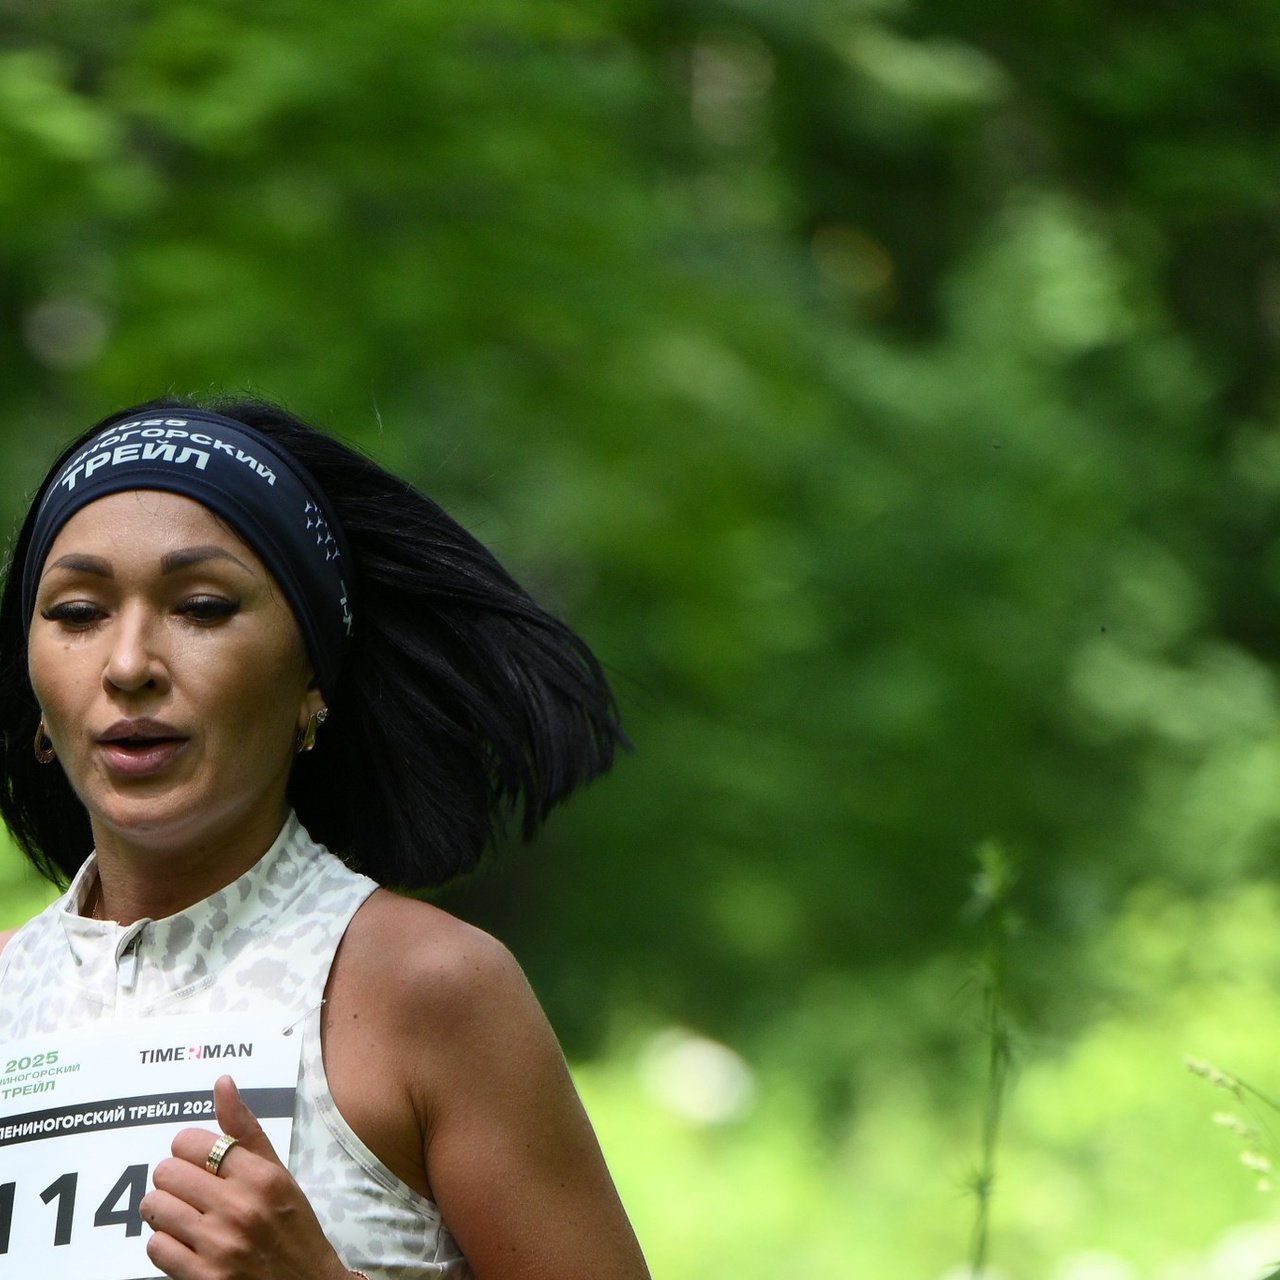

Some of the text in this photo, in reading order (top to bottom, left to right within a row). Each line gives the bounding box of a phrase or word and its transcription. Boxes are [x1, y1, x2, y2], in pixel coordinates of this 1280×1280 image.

[62, 439, 211, 492] ТРЕЙЛ
[4, 1050, 59, 1074] 2025
[1, 1080, 56, 1100] ТРЕЙЛ
[129, 1101, 180, 1121] ТРЕЙЛ
[182, 1100, 216, 1115] 202
